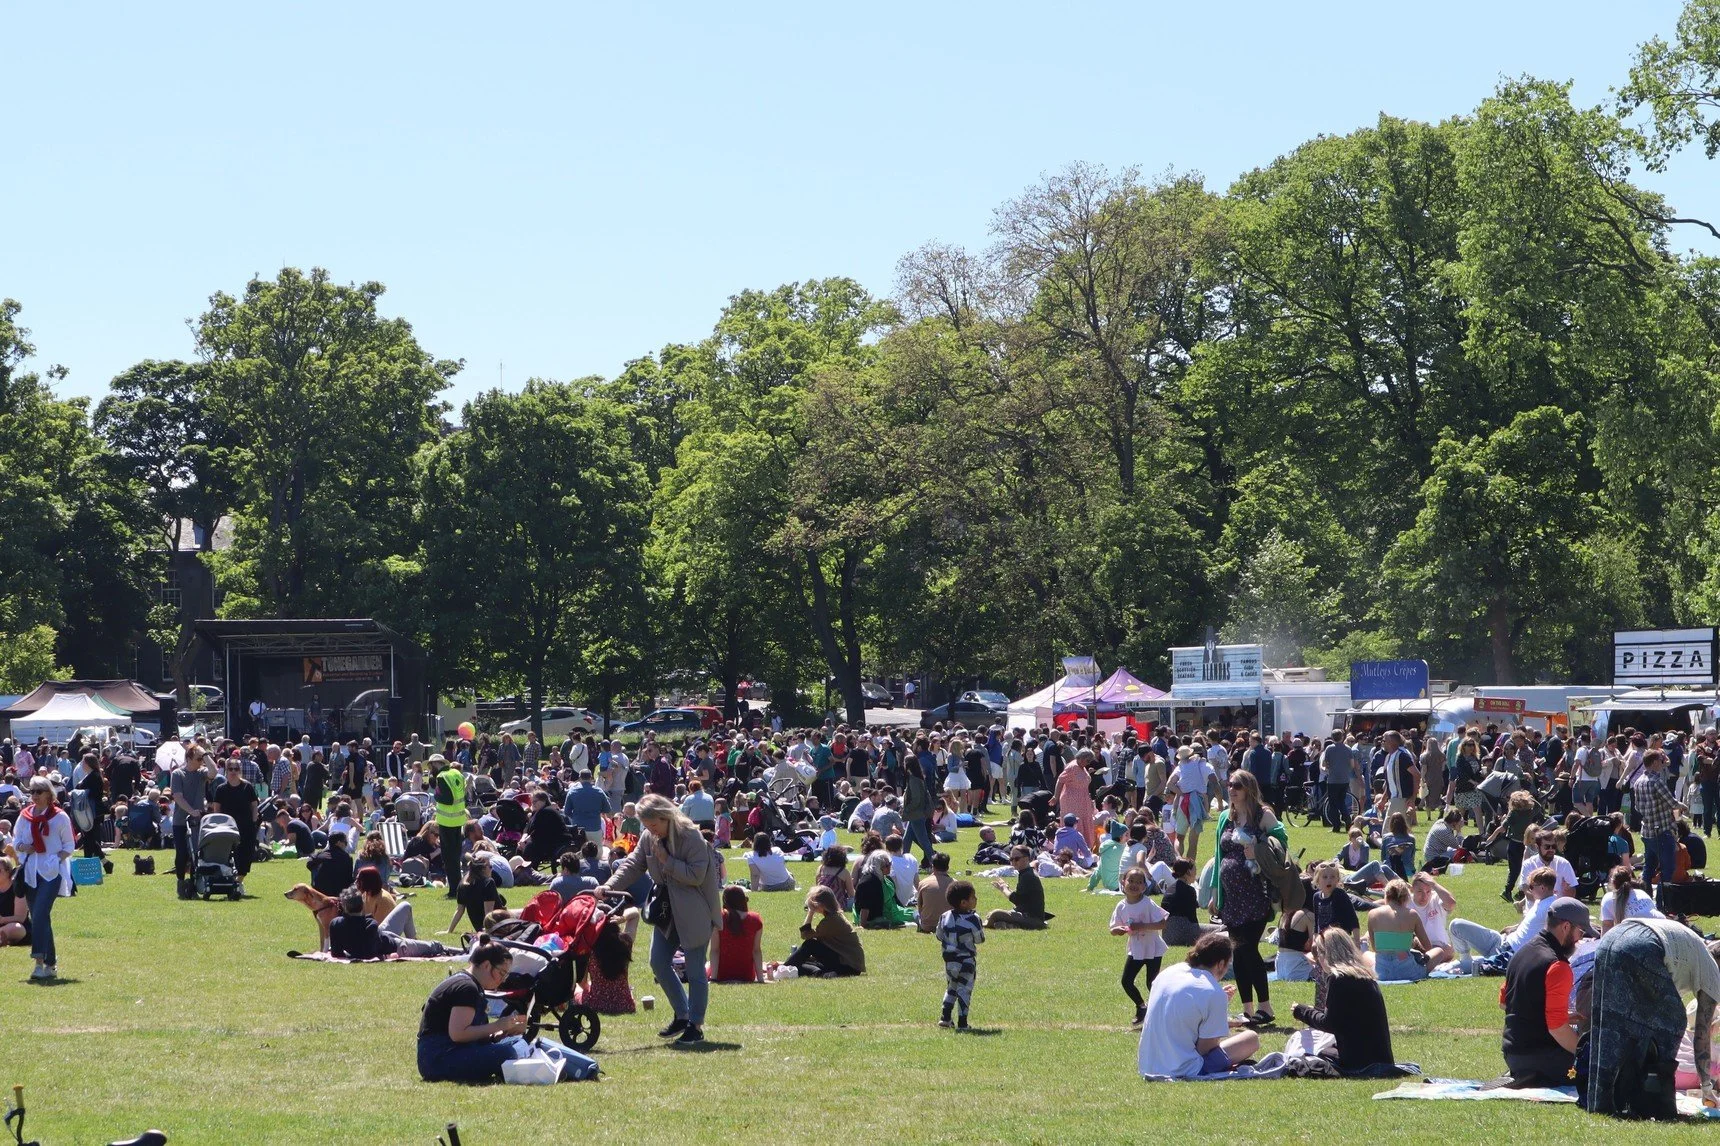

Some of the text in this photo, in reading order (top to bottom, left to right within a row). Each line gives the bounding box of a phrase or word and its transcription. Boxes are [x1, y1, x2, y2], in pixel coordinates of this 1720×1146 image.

[1623, 650, 1704, 669] PIZZA
[1202, 661, 1231, 681] ALANDAS
[1360, 663, 1391, 680] Mutleys
